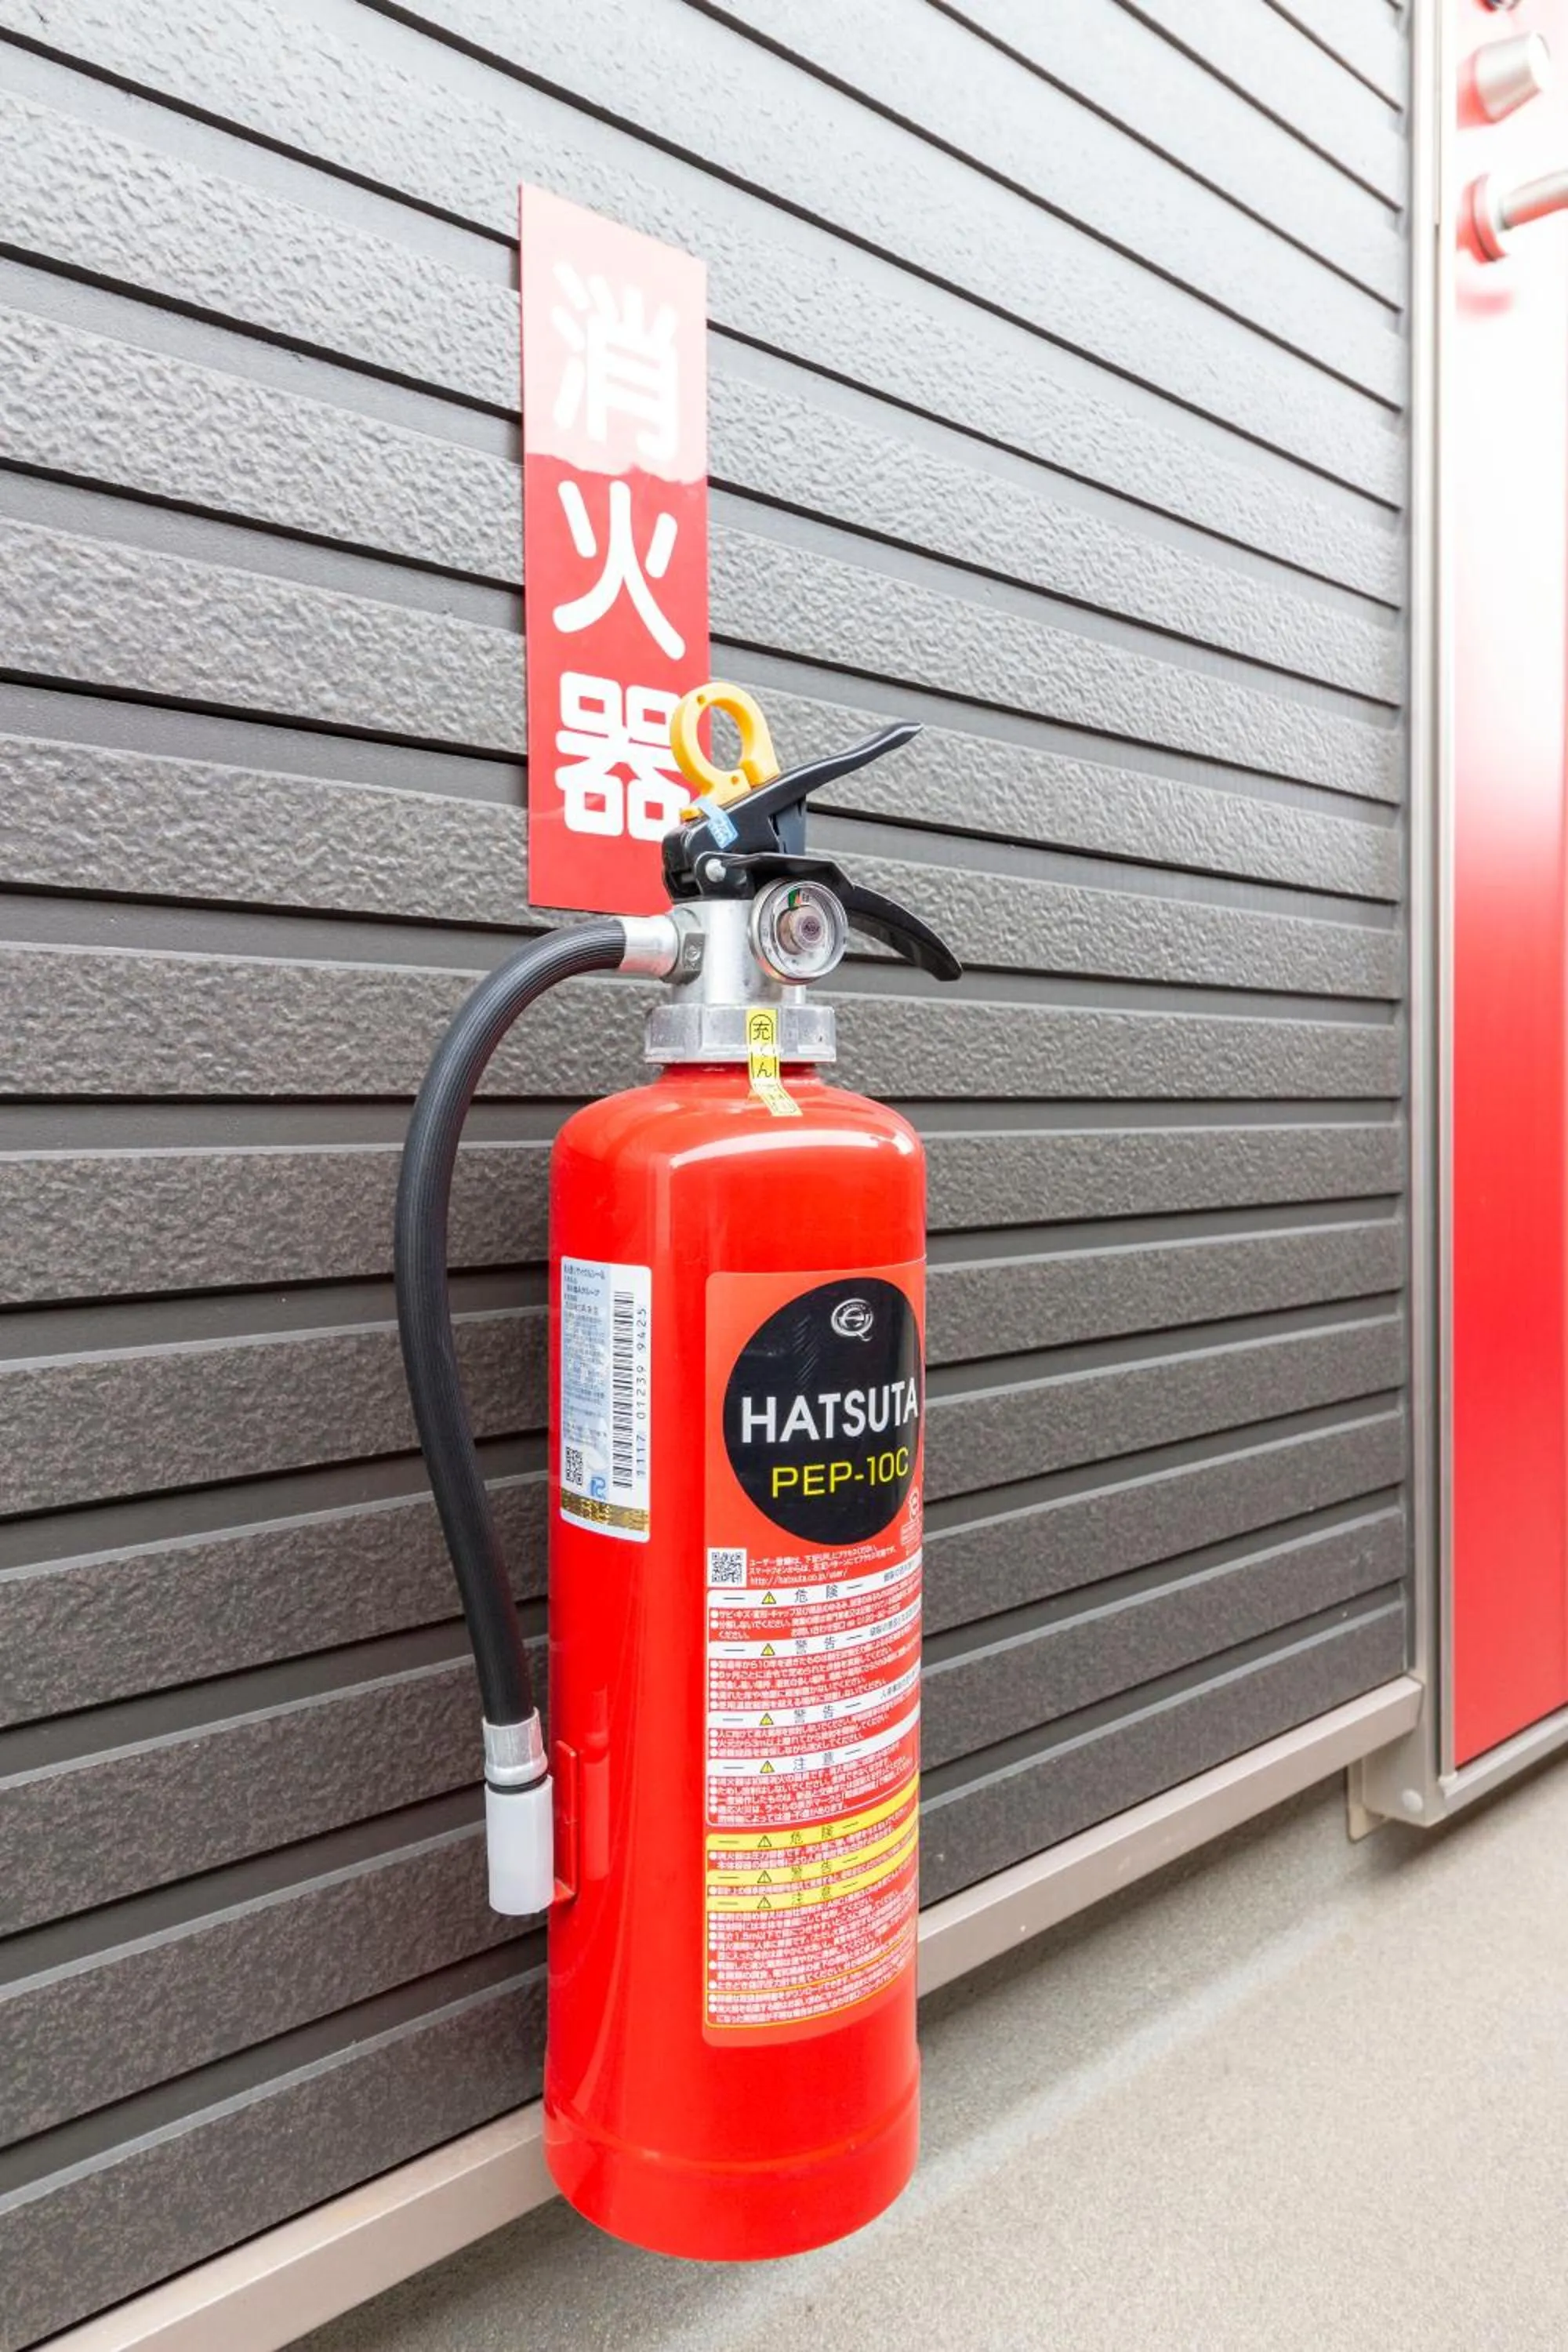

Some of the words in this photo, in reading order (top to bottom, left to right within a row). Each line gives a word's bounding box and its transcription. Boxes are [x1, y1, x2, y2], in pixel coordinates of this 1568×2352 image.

[551, 262, 686, 842] 消火器
[742, 1377, 918, 1443] HATSUTA
[772, 1446, 909, 1498] PEP-10C
